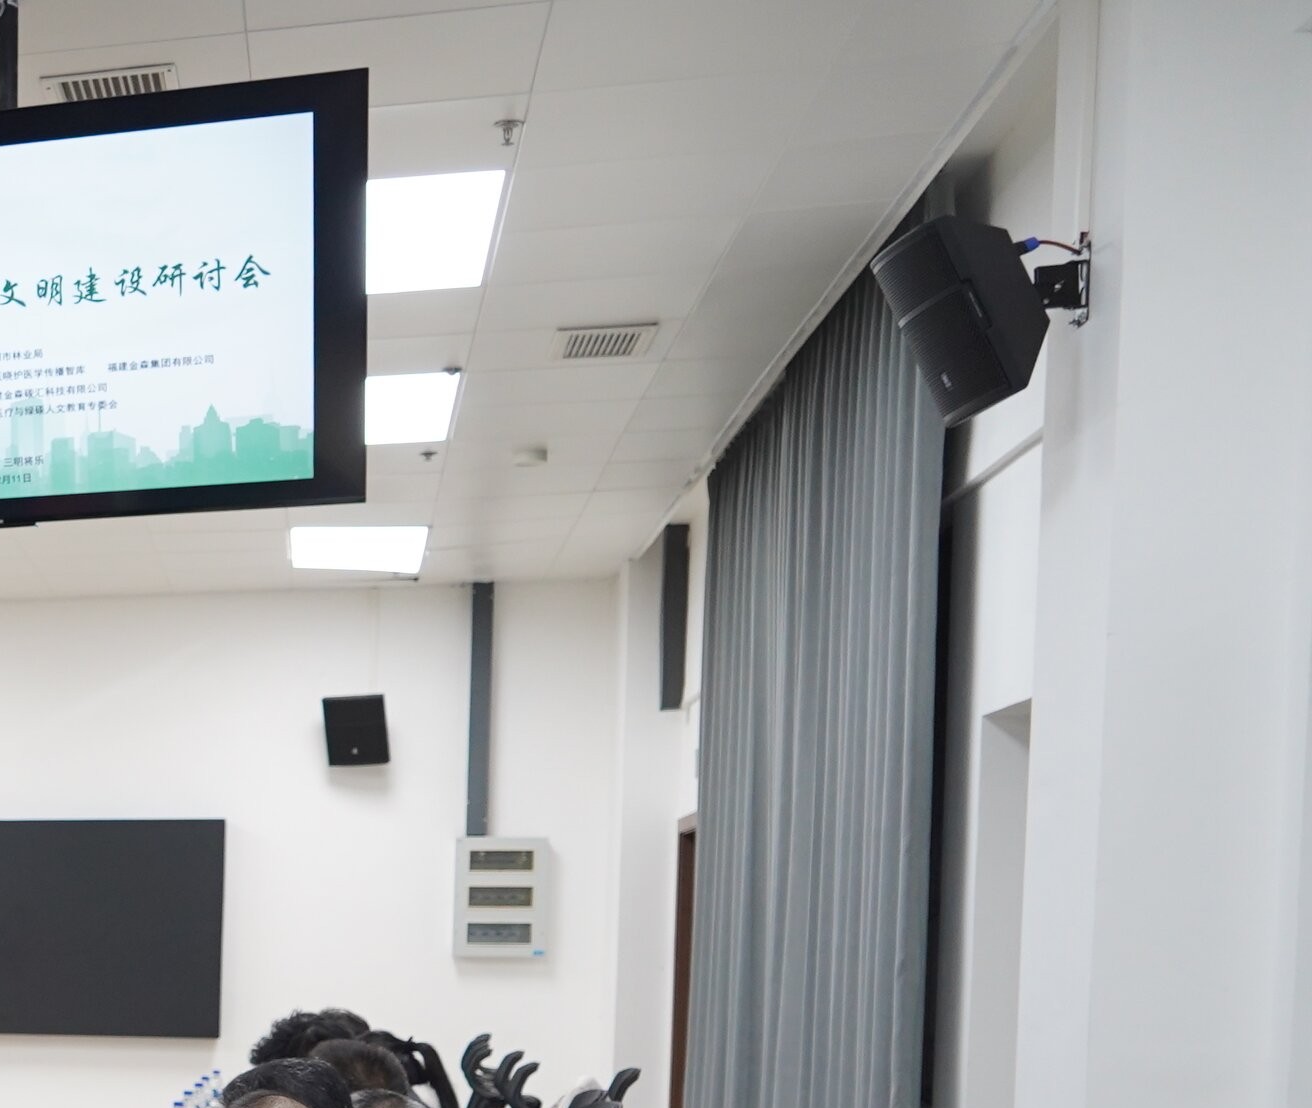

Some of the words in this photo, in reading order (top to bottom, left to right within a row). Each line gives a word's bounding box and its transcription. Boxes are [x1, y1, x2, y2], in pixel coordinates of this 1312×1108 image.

[108, 354, 215, 372] 福建金森集团有限公司
